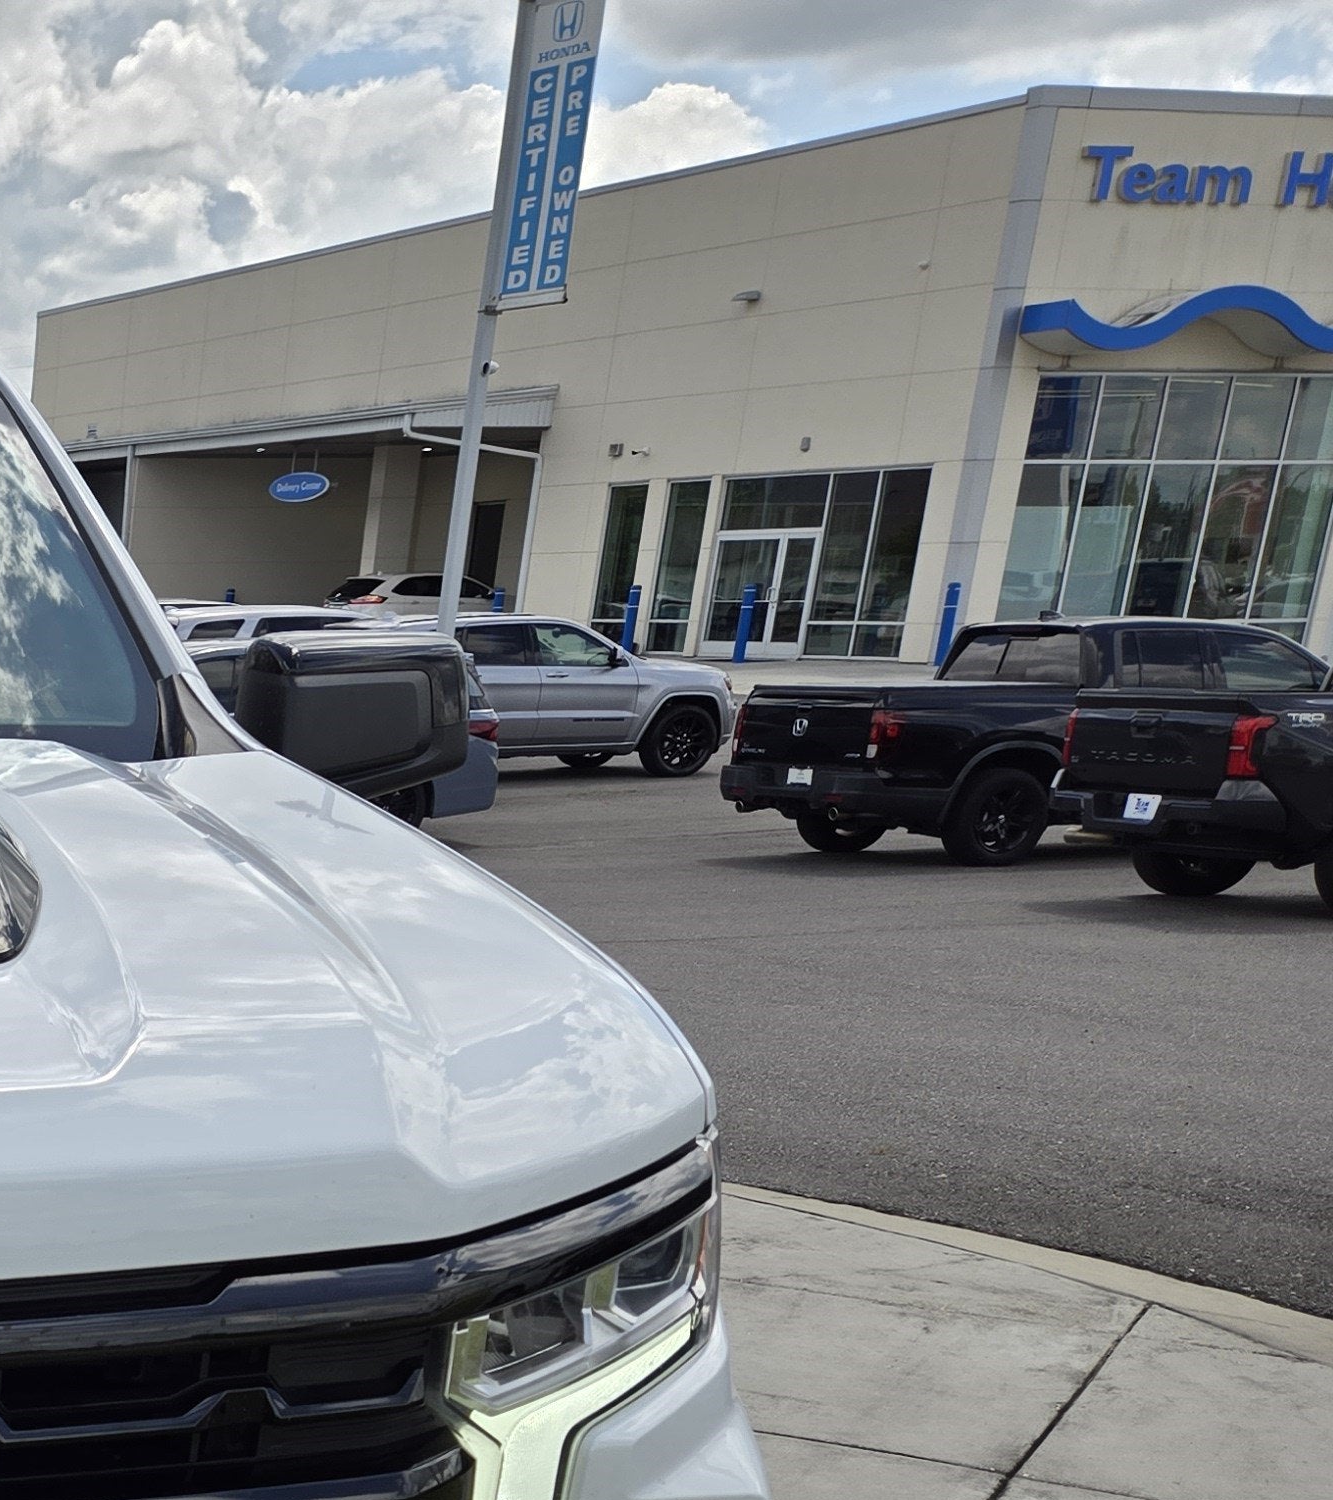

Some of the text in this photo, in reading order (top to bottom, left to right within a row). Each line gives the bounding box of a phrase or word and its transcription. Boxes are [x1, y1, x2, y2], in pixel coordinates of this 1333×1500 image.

[538, 41, 591, 63] HONDA
[506, 73, 554, 290] CERTIFIED
[544, 65, 588, 284] PRE OWNED
[1084, 145, 1253, 204] Team
[1287, 712, 1325, 723] TRD
[1091, 750, 1196, 765] TACOMA
